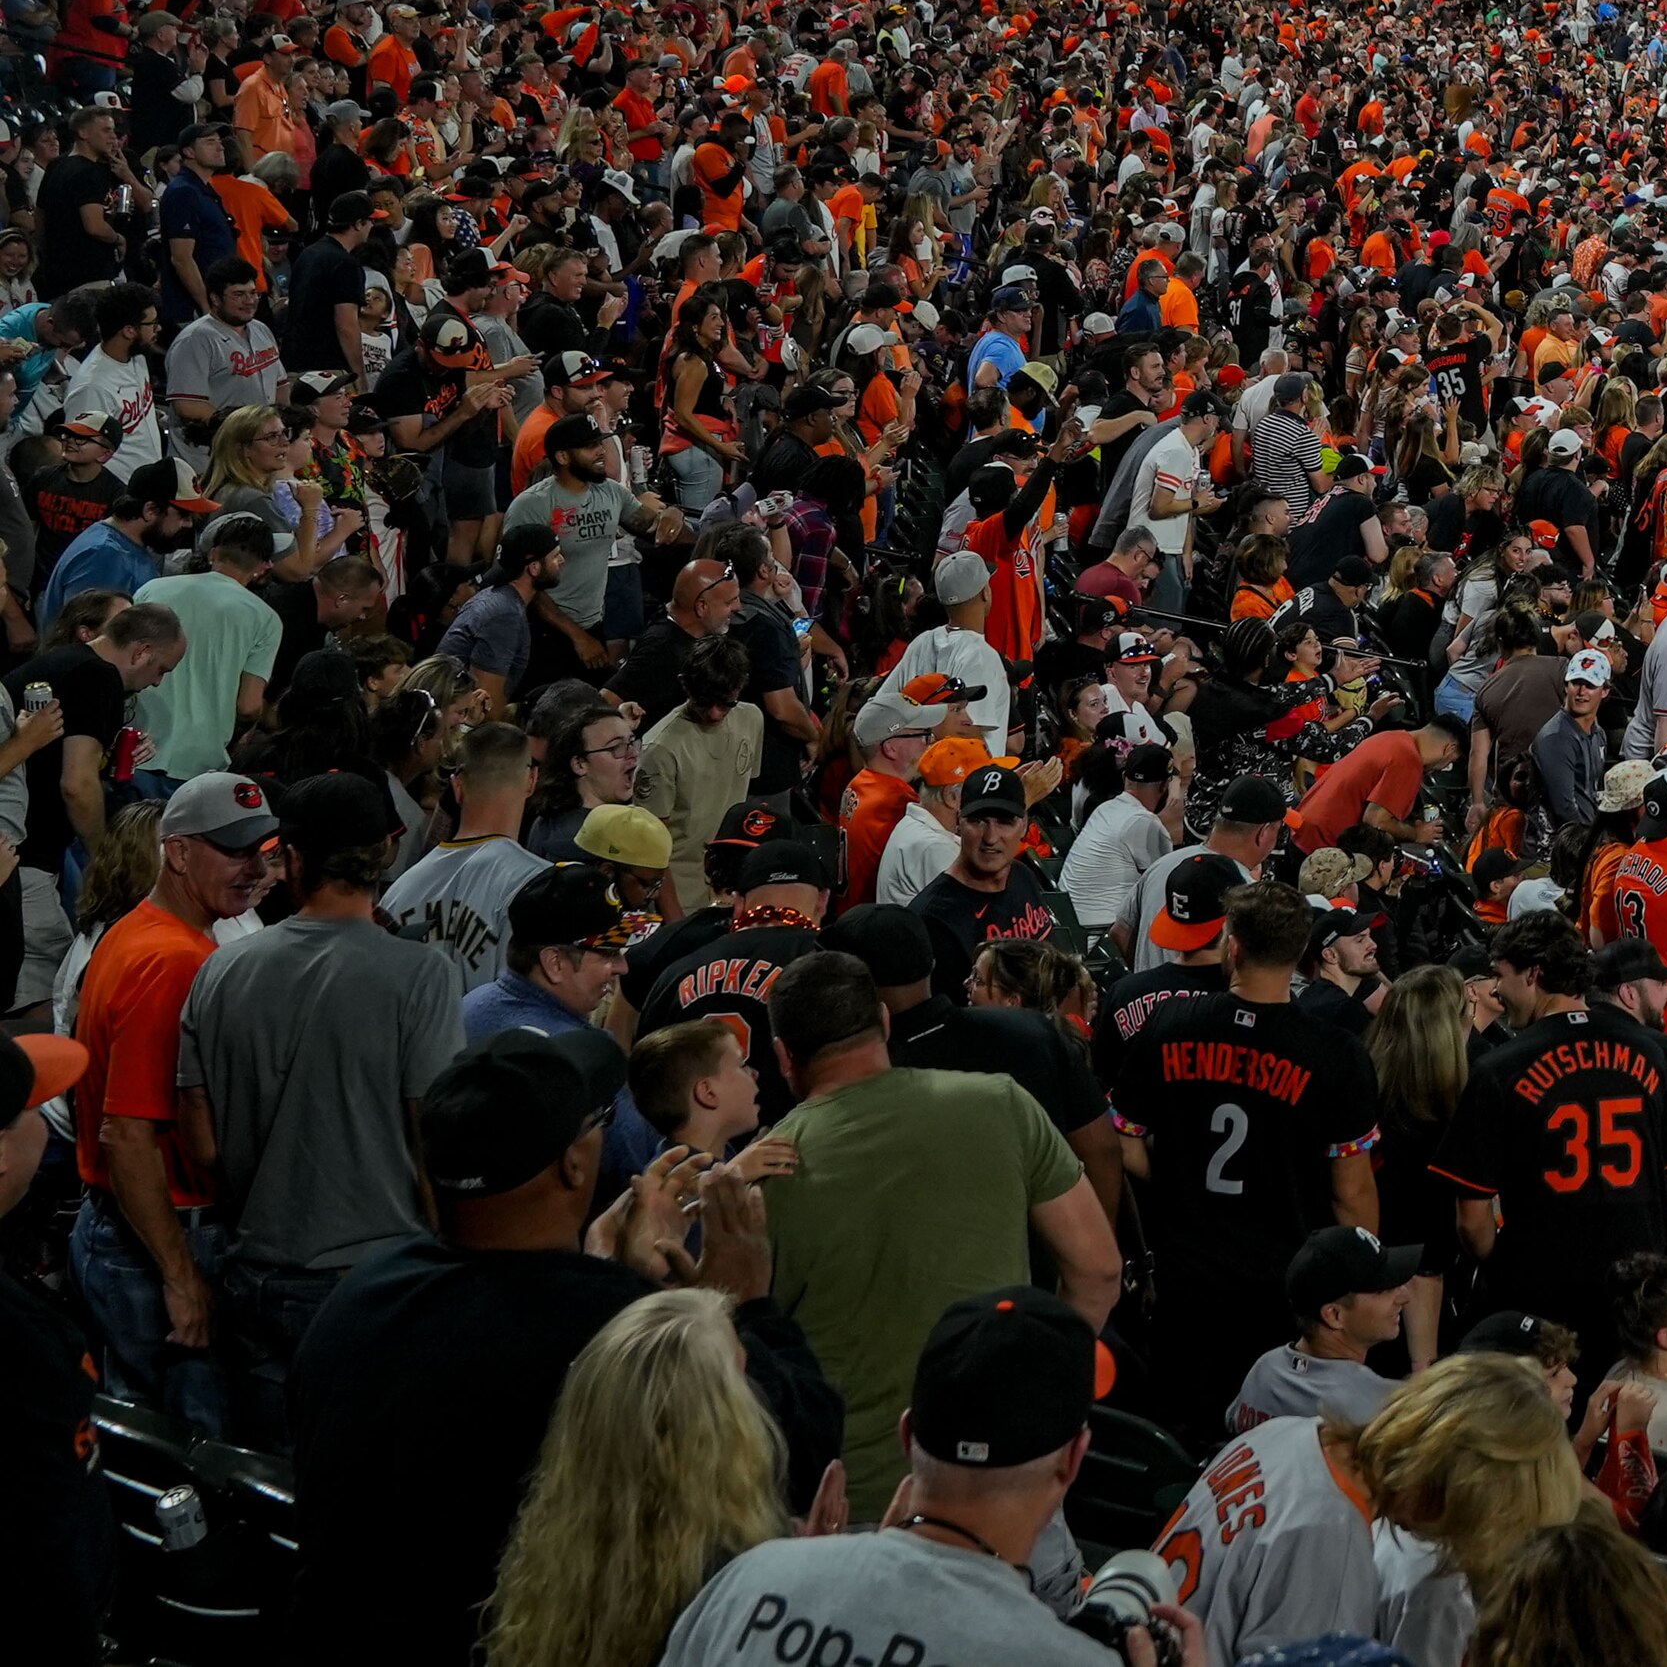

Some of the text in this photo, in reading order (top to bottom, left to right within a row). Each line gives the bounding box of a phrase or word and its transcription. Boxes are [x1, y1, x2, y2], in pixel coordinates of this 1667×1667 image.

[1437, 368, 1466, 398] 35
[567, 510, 612, 527] CHARM
[579, 524, 606, 538] CITY
[981, 770, 1002, 794] B
[1171, 891, 1190, 919] E
[1161, 1040, 1312, 1107] HENDERSON
[1514, 1040, 1660, 1106] RUTSCHMAN
[1205, 1102, 1249, 1196] 2
[1544, 1096, 1644, 1192] 35
